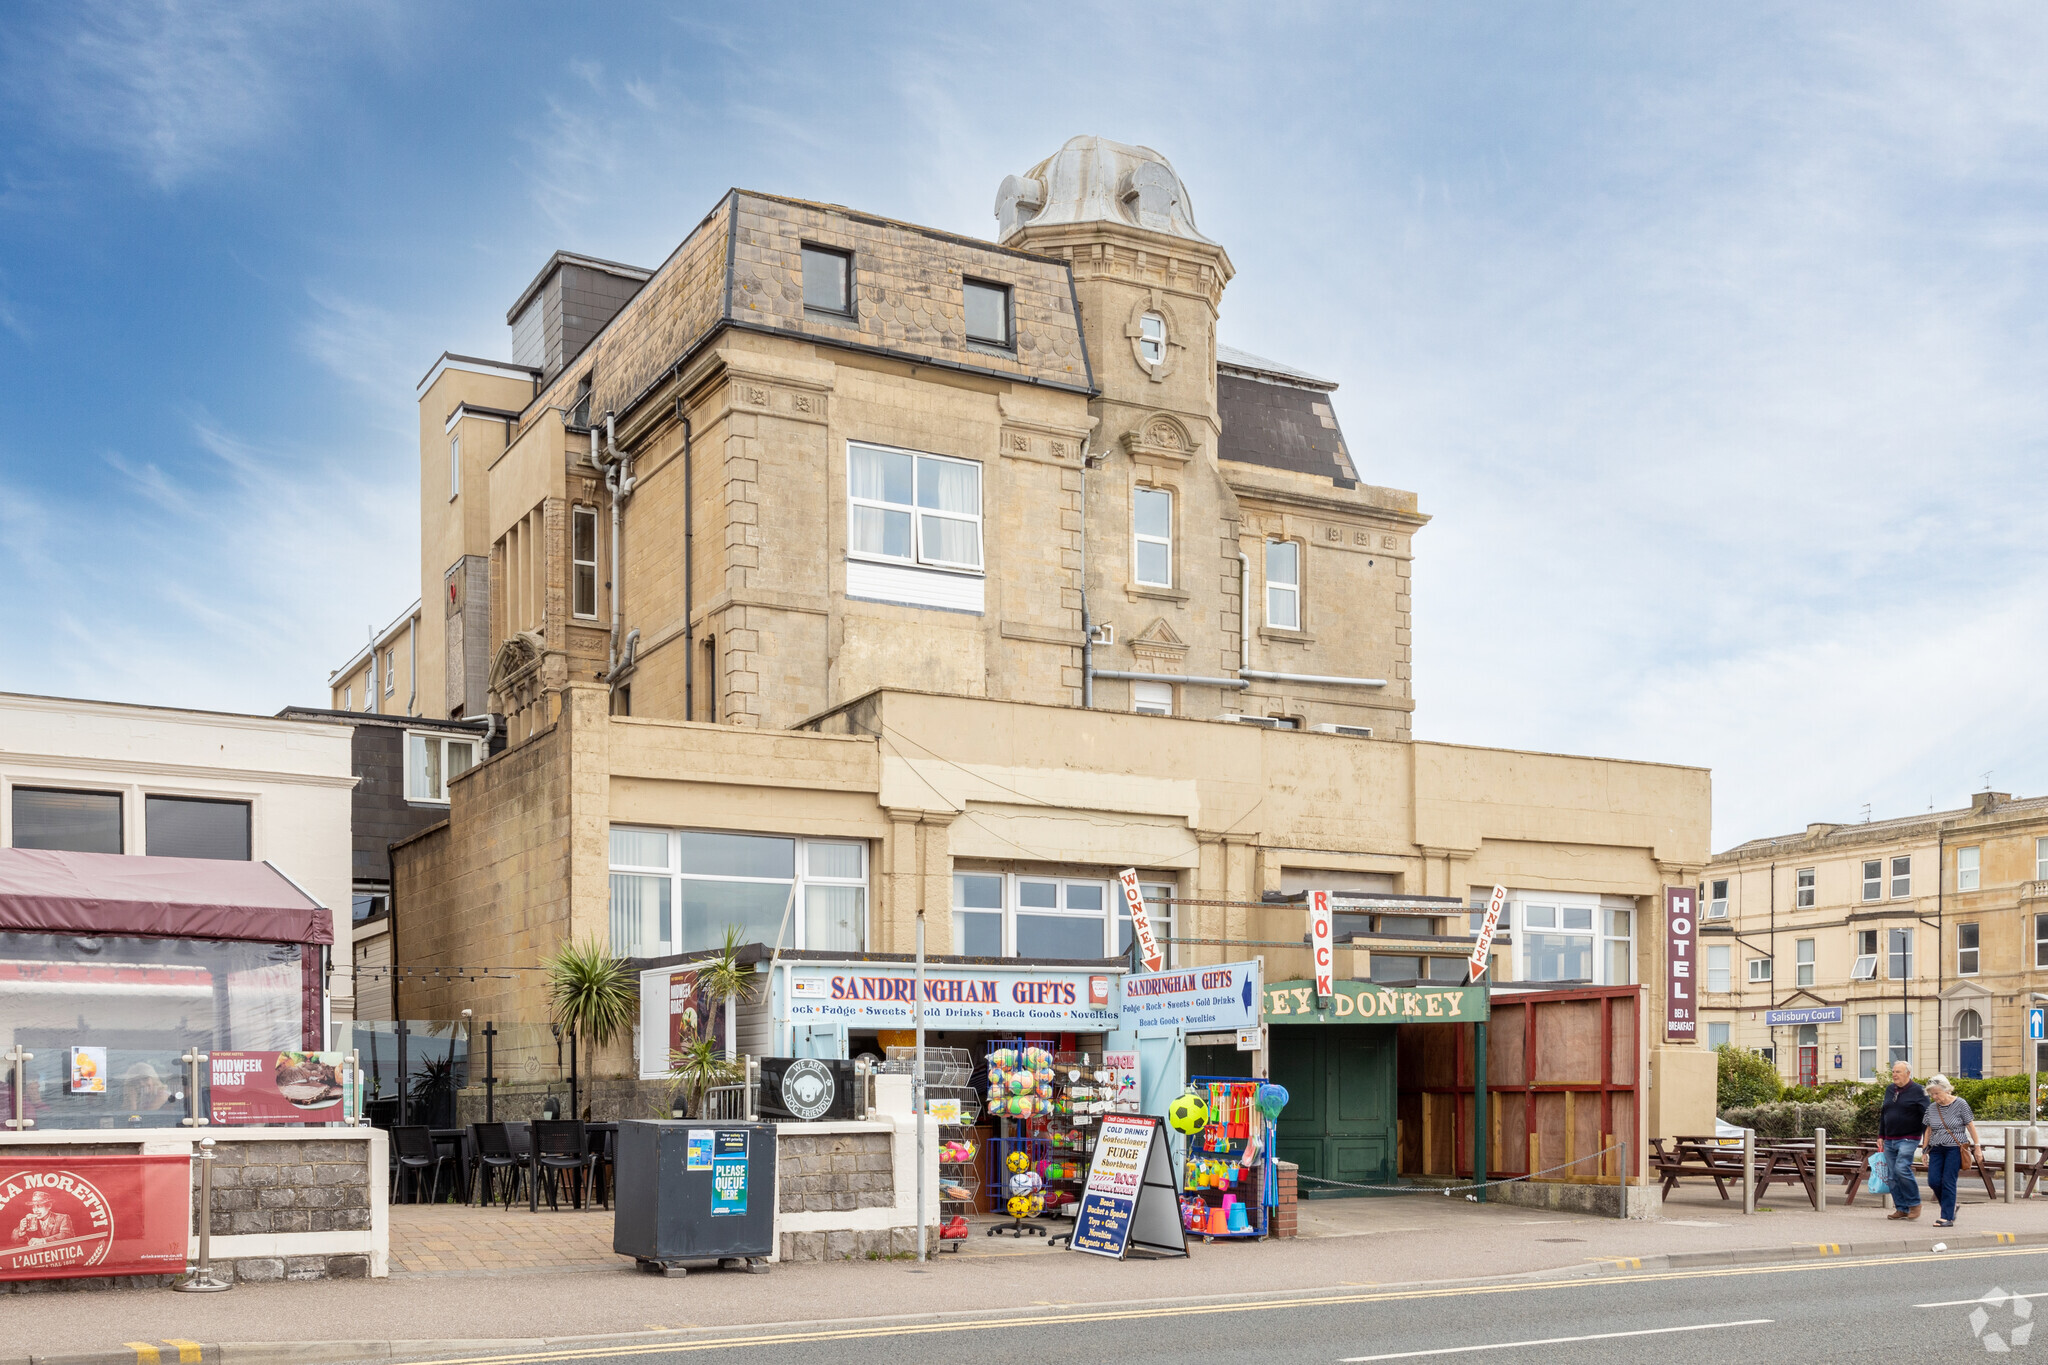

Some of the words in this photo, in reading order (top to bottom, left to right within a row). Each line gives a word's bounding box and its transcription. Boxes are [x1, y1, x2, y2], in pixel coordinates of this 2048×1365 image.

[1122, 872, 1156, 957] WONKEY
[1476, 888, 1504, 962] DONKEY
[1314, 892, 1331, 994] ROCK
[1672, 896, 1691, 998] HOTEL
[831, 976, 1000, 1004] SANDRINGHAM
[1012, 979, 1076, 1005] GIFTS
[1127, 974, 1197, 997] SANDRINGHAM
[1202, 970, 1232, 990] GIFTS
[1123, 1004, 1140, 1013] Fudge
[1146, 1002, 1162, 1010] Rock
[1167, 1001, 1190, 1009] Sweets
[1213, 996, 1235, 1005] Drinks
[1334, 991, 1463, 1017] DONKEY
[792, 1005, 813, 1014] ock
[822, 1006, 856, 1016] Fudge
[866, 1006, 906, 1016] Sweets
[924, 1008, 940, 1017] old
[946, 1008, 983, 1017] Drinks
[992, 1008, 1024, 1018] Beach
[1028, 1009, 1061, 1018] Goods
[1070, 1010, 1119, 1019] Novelties
[1674, 1009, 1683, 1018] BED
[1684, 1009, 1689, 1018] &
[1772, 1012, 1809, 1022] Salisbury
[1812, 1011, 1835, 1019] Court
[1140, 1018, 1158, 1027] Beach
[1160, 1016, 1179, 1025] Goods
[1186, 1014, 1216, 1024] Novelties
[1669, 1022, 1694, 1031] BREAKFAST
[212, 1059, 263, 1072] MIDWEEK
[792, 1062, 805, 1072] WE
[808, 1061, 823, 1072] ARE
[1106, 1055, 1134, 1069] ROCK
[213, 1072, 246, 1086] ROAST
[785, 1094, 799, 1112] DOG
[801, 1095, 831, 1117] FRIENDLY
[1124, 1128, 1148, 1136] DRINKS
[1102, 1135, 1147, 1148] Confectionery
[1107, 1146, 1138, 1159] FUDGE
[716, 1165, 745, 1176] PLEASE
[1101, 1158, 1137, 1170] Shortbread
[715, 1177, 745, 1192] QUEUE
[1114, 1172, 1138, 1186] ROCK
[24, 1173, 108, 1228] MORETTI
[721, 1190, 738, 1200] HERE
[1099, 1198, 1115, 1207] Beach
[1087, 1205, 1105, 1215] Bucket
[1110, 1209, 1127, 1219] Spades
[1088, 1217, 1100, 1227] Toys
[1105, 1219, 1118, 1229] Gifts
[1088, 1228, 1112, 1239] Novelties
[1078, 1236, 1100, 1248] Magnets
[1104, 1241, 1120, 1251] Shells
[12, 1245, 84, 1269] L'AUTENTICA
